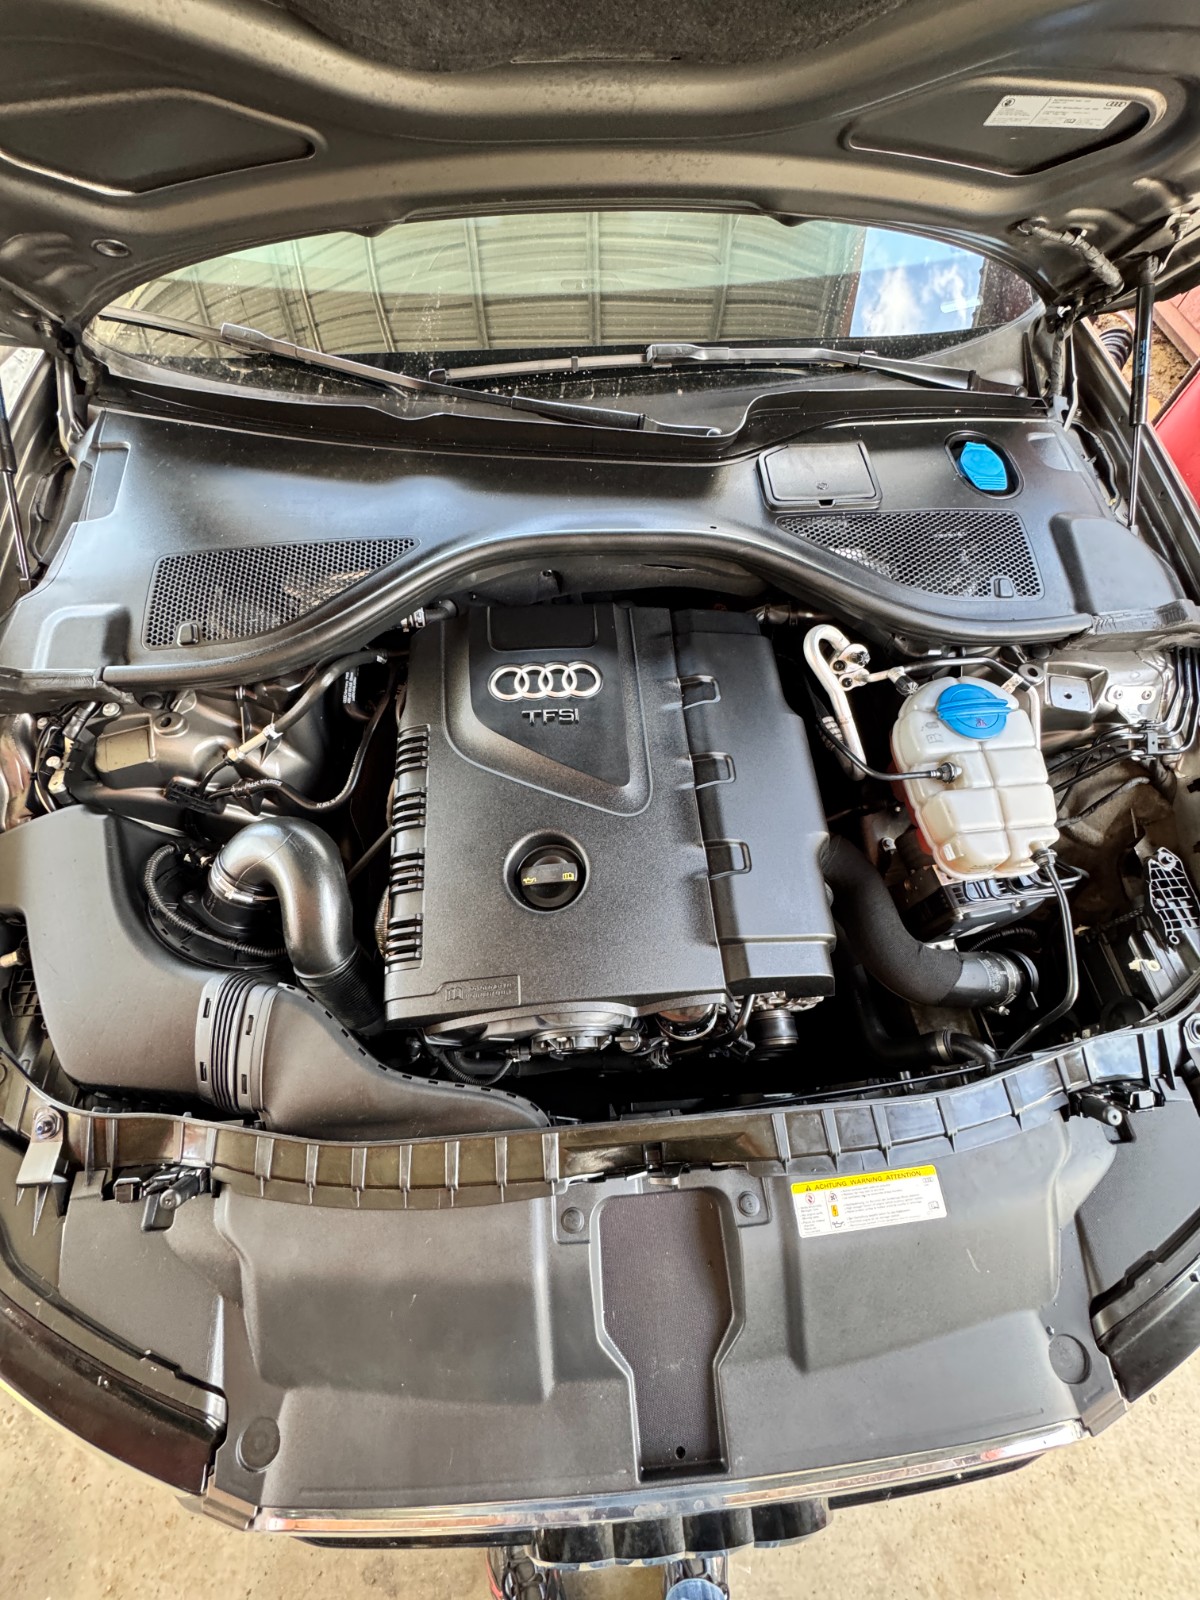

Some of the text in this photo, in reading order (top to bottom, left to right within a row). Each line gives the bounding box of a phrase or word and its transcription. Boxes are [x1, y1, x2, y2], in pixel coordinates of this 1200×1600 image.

[521, 708, 580, 725] TFSI
[814, 1171, 922, 1191] ACHTUNG WARNING ATTENTION
